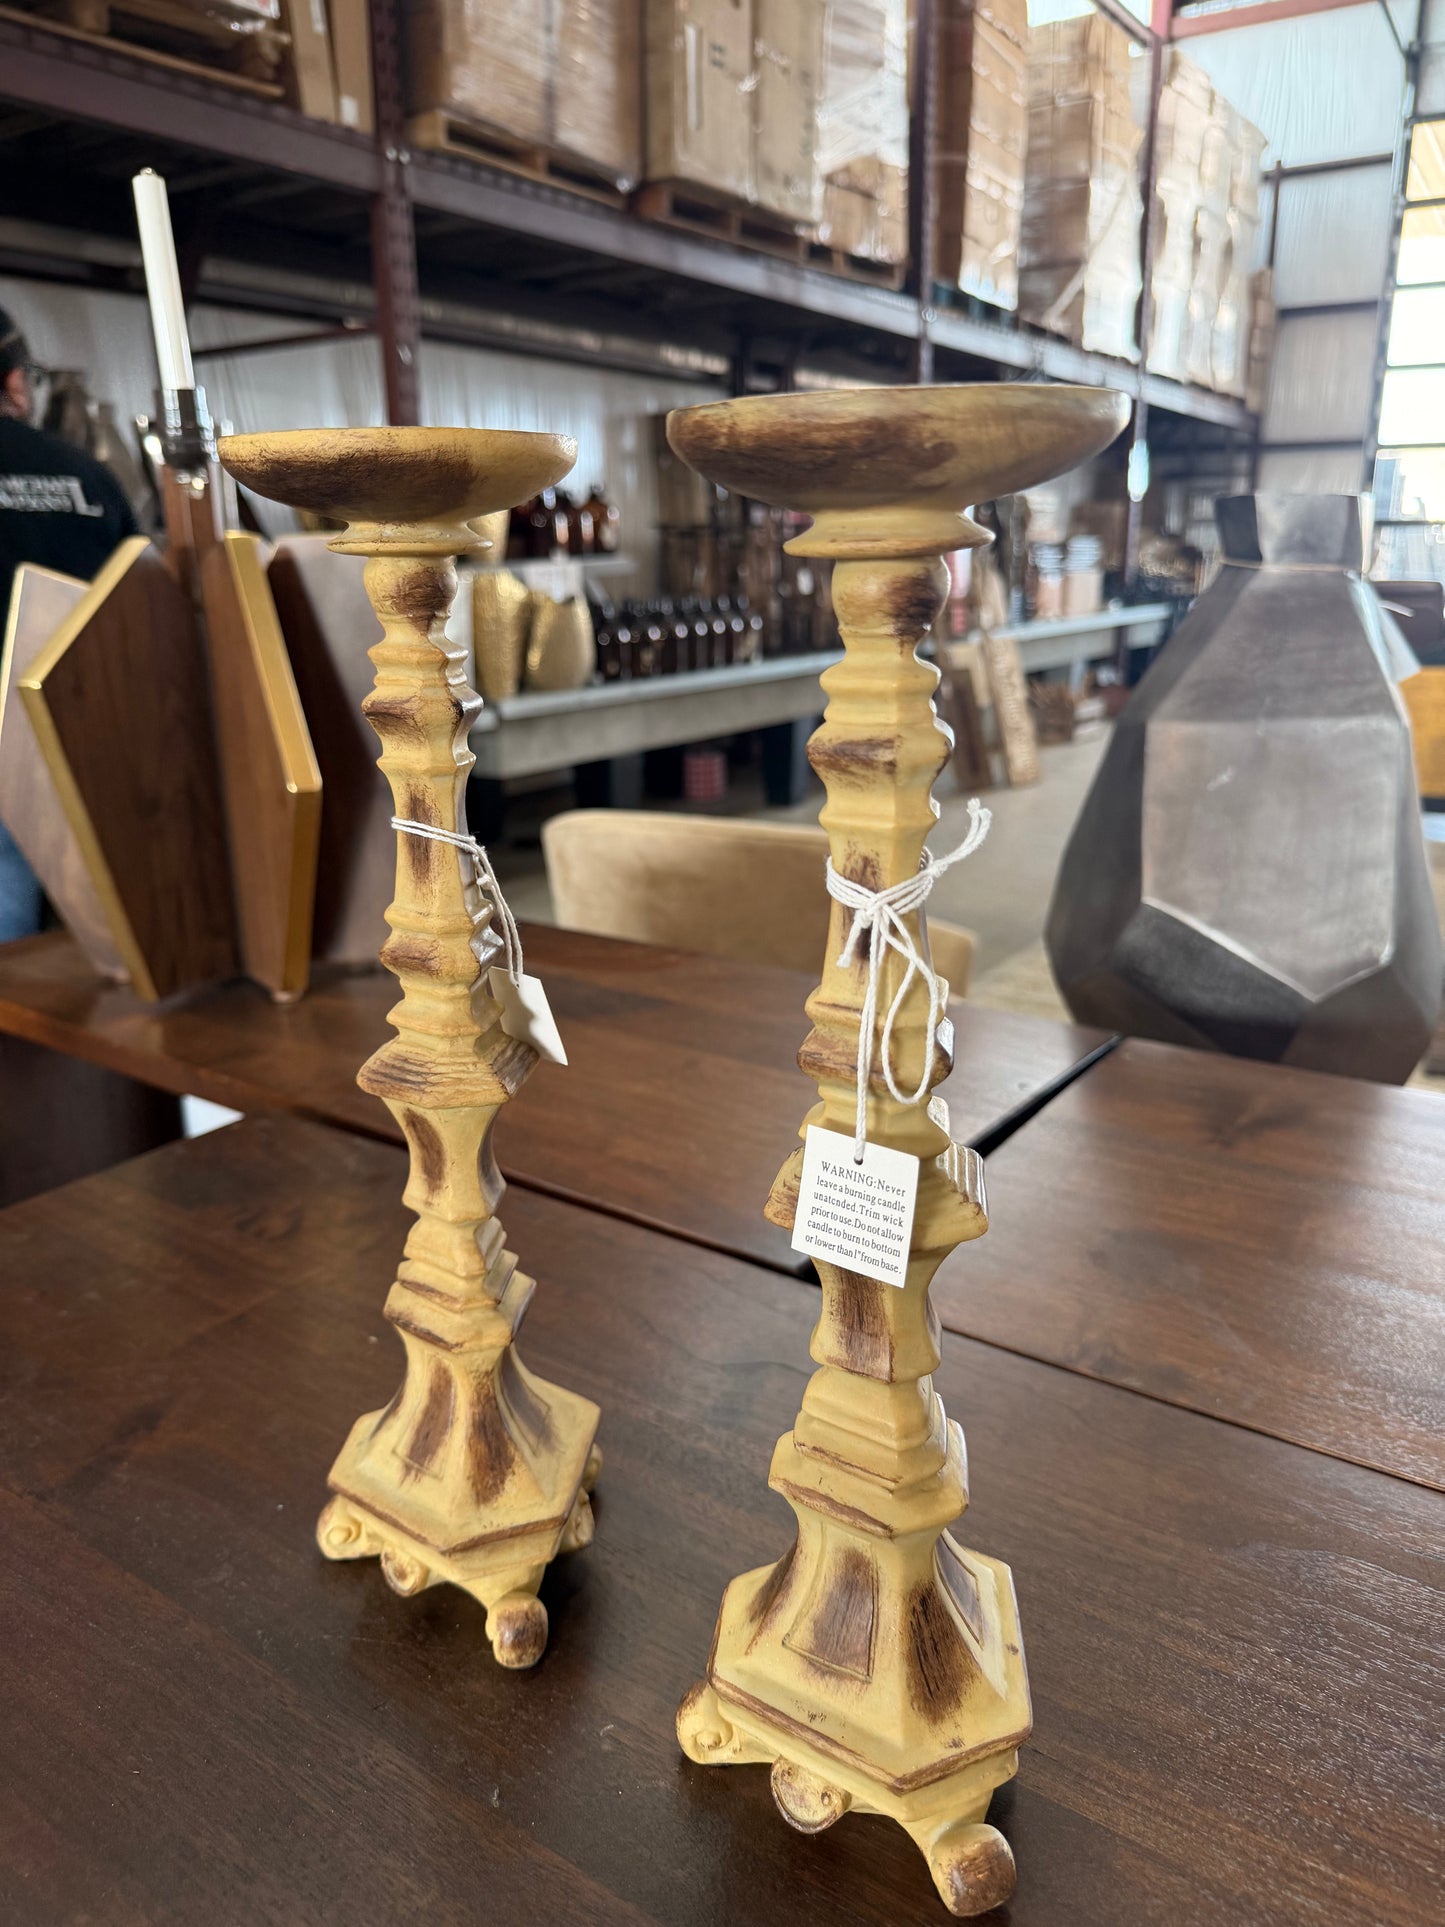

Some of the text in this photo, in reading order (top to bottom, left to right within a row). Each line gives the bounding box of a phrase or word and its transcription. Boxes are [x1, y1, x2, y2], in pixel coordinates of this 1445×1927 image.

[816, 1175, 906, 1213] leave a burning candle
[807, 1220, 901, 1258] candle to burn to bottom
[810, 1206, 830, 1218] prior
[830, 1212, 838, 1221] to
[866, 1225, 880, 1236] not
[880, 1228, 904, 1242] allow
[882, 1214, 903, 1228] wick
[805, 1235, 814, 1243] or
[814, 1235, 836, 1251] lower
[836, 1244, 853, 1258] than
[880, 1258, 901, 1274] base.
